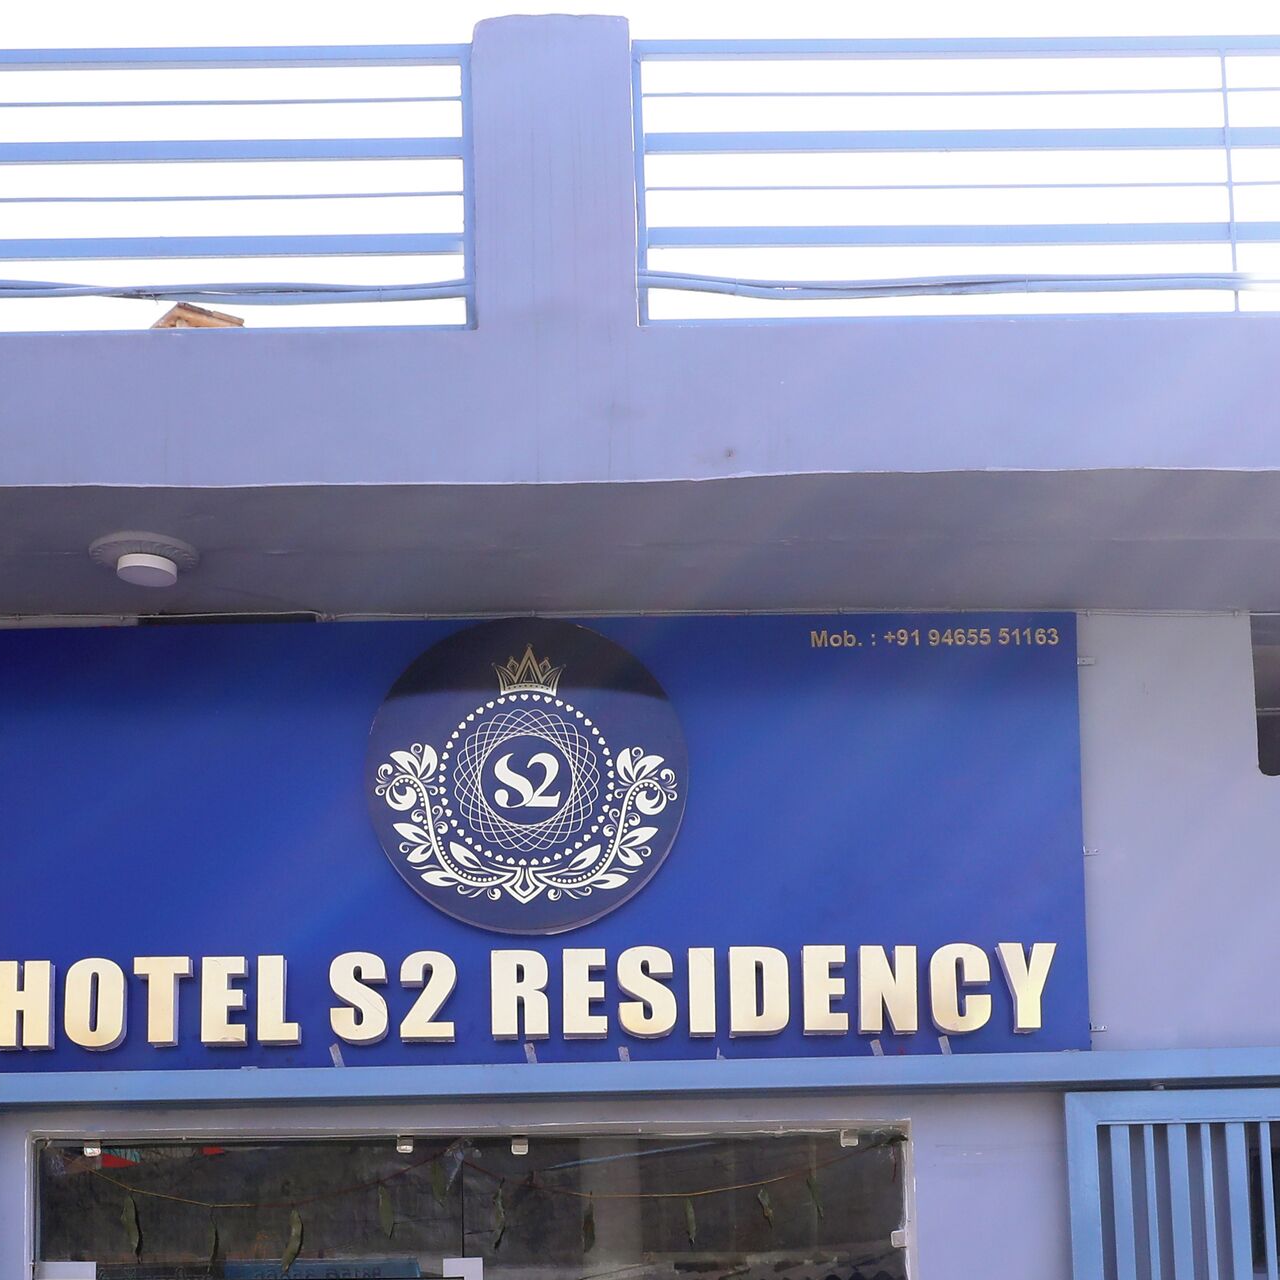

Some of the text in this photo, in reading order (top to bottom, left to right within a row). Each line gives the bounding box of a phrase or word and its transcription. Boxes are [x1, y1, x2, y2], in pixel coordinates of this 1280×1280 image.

[810, 630, 862, 648] Mob.
[884, 629, 920, 646] +91
[928, 628, 991, 646] 94655
[998, 627, 1060, 645] 51163
[493, 751, 563, 809] S2
[328, 950, 458, 1046] S2
[490, 942, 1058, 1042] RESIDENCY
